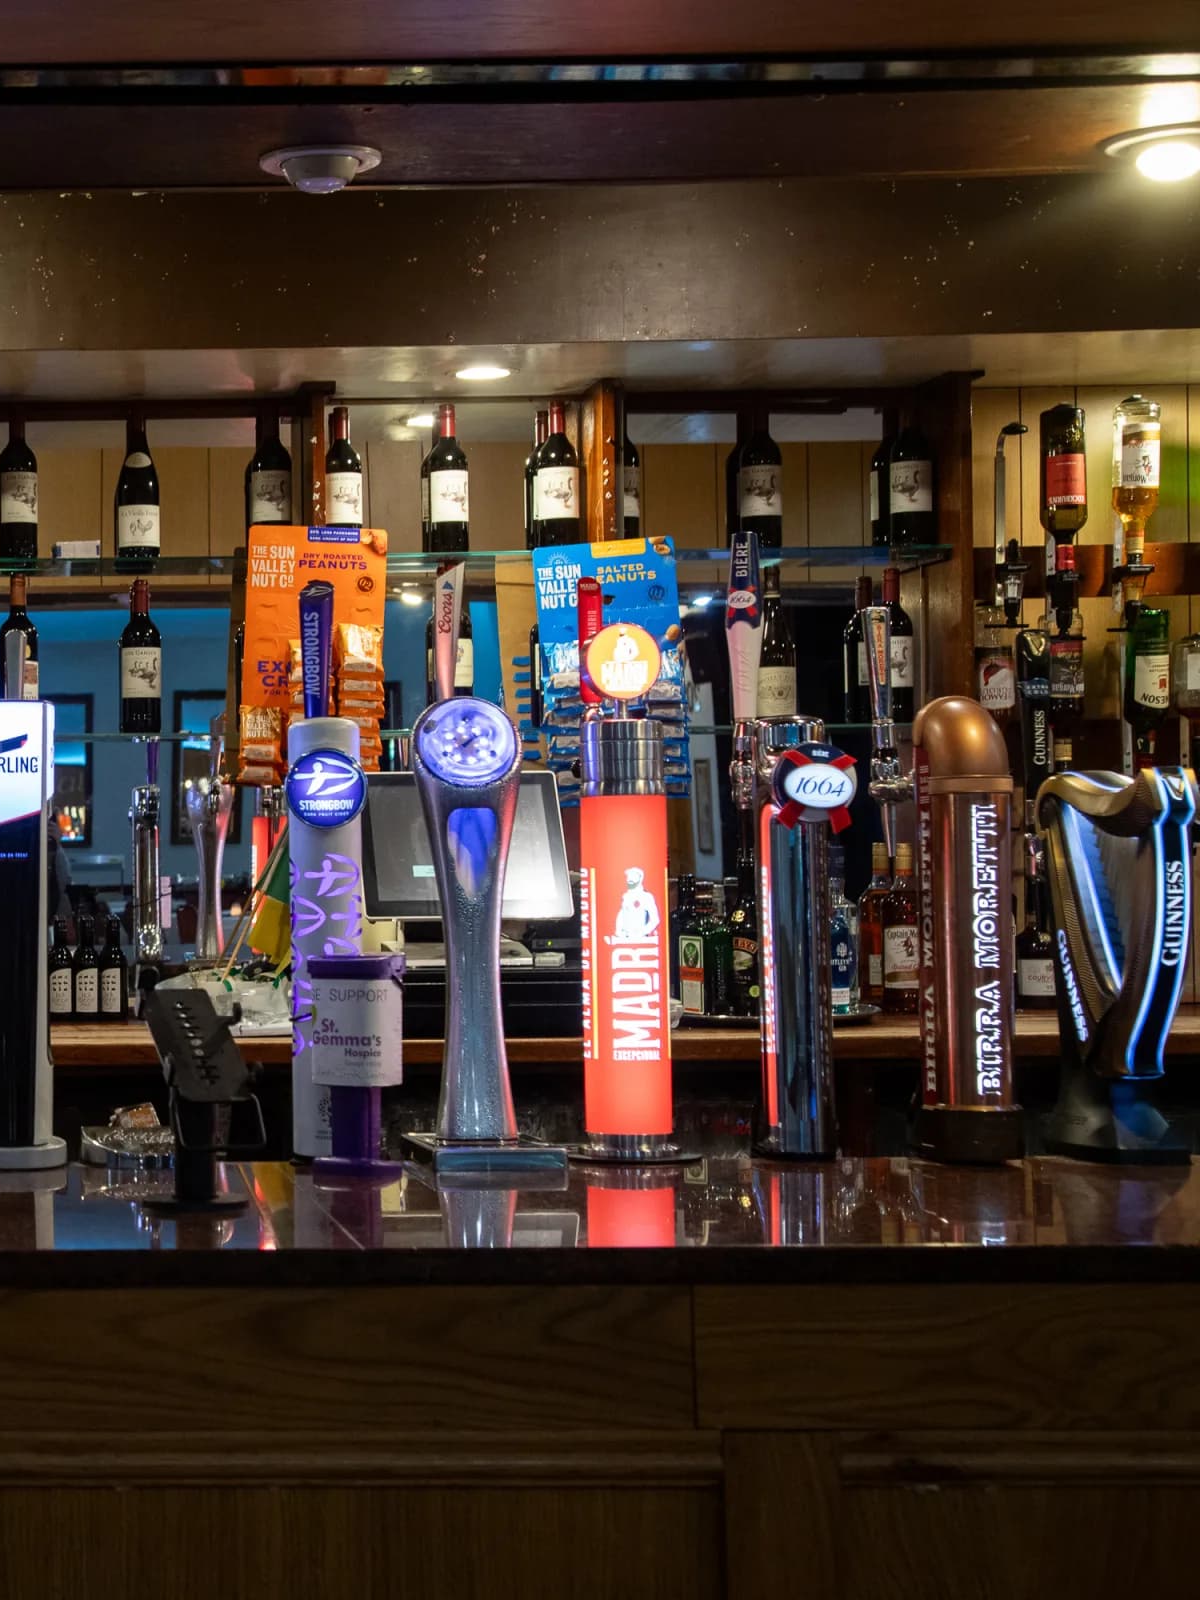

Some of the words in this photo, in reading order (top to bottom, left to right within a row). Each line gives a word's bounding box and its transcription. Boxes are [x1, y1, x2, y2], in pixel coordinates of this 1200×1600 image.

[252, 545, 267, 555] THE
[270, 545, 295, 559] SUN
[323, 553, 363, 561] ROASTED
[251, 560, 296, 573] VALLEY
[299, 560, 367, 570] PEANUTS
[537, 567, 553, 580] THE
[555, 564, 581, 579] SUN
[596, 563, 644, 575] SALTED
[251, 574, 277, 588] NUT
[591, 571, 657, 584] EANUTS
[541, 594, 567, 610] NUT
[438, 592, 453, 634] Coors
[304, 612, 321, 699] STRONGBOW
[1033, 710, 1046, 766] GUINNESS
[795, 775, 846, 797] 1664
[298, 798, 355, 811] STRONGBOW
[970, 804, 1001, 969] MORETTI
[579, 867, 589, 939] MADRID
[1161, 859, 1186, 967] GUINNESS
[581, 948, 590, 970] DE
[329, 988, 388, 1002] SUPPORT
[582, 980, 591, 1030] ALMA
[321, 1018, 340, 1033] St.
[313, 1031, 382, 1047] Gemma's
[975, 980, 1004, 1096] BIRRA
[344, 1048, 382, 1058] Hospice
[583, 1039, 592, 1059] EL
[612, 1050, 661, 1061] EXCEPCIONAL
